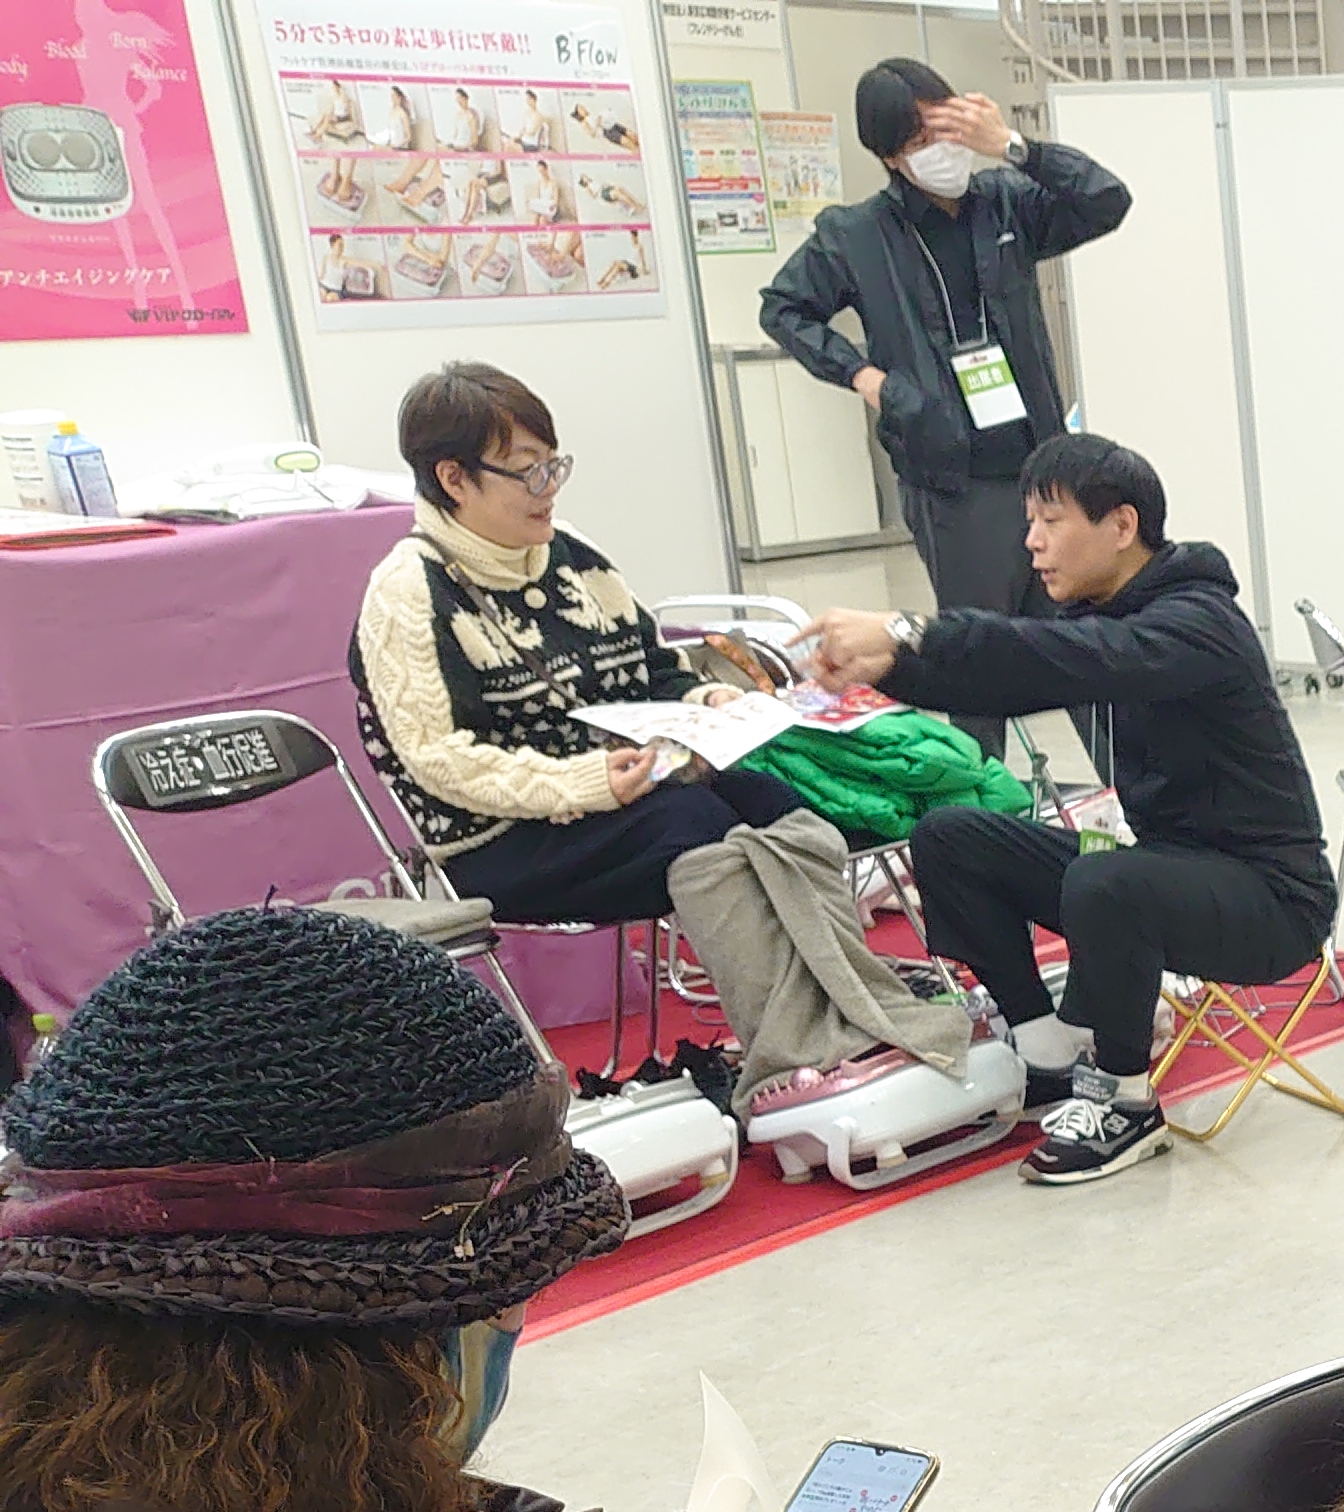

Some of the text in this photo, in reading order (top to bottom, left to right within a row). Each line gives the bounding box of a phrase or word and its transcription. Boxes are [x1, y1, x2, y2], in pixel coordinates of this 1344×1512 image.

[0, 54, 29, 83] ody
[0, 267, 171, 286] アンチエイジングケア
